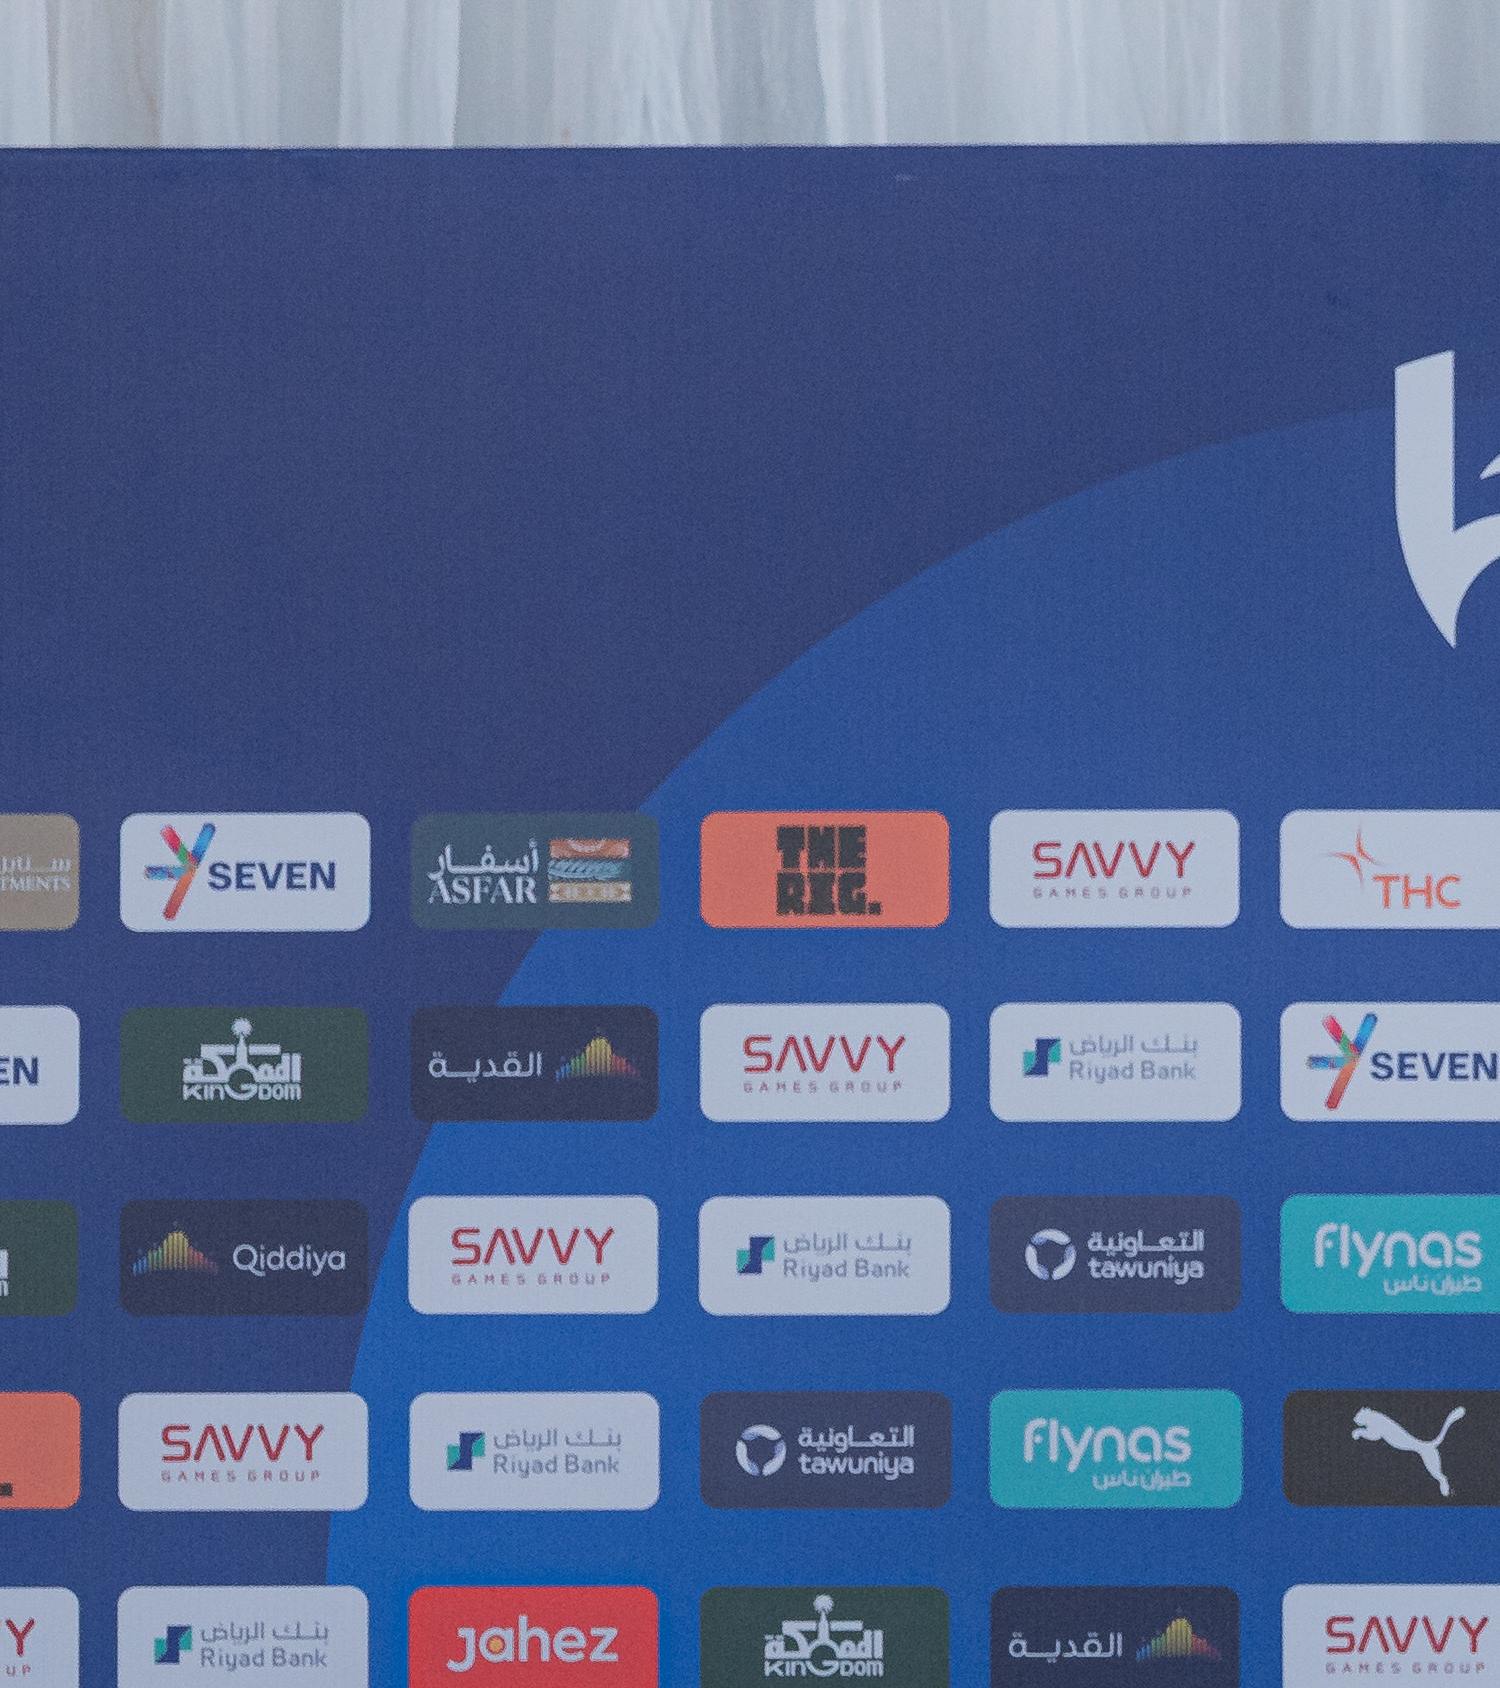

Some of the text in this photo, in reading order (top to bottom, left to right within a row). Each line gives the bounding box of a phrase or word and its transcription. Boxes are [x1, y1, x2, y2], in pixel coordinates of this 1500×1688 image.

[777, 825, 867, 871] THE
[1032, 841, 1195, 880] SAVVY
[209, 861, 336, 892] SEVEN
[428, 877, 537, 904] ASFAR
[1373, 874, 1463, 910] THC
[428, 1052, 542, 1081] القدية
[742, 1035, 906, 1074] SAVVY
[1371, 1051, 1499, 1082] SEVEN
[1069, 1062, 1196, 1085] Riyad Bank
[232, 1242, 346, 1277] Qiddiya
[450, 1227, 614, 1266] SAVVY
[1314, 1222, 1483, 1278] flynas
[783, 1260, 910, 1283] Riyad Bank
[1087, 1257, 1205, 1285] tawuniya
[160, 1424, 324, 1463] SAVVY
[1023, 1417, 1192, 1473] flynas
[493, 1456, 620, 1479] Riyad Bank
[797, 1453, 915, 1481] tawuniya
[1007, 1633, 1123, 1661] القدية
[1325, 1616, 1489, 1655] SAVVY
[201, 1649, 327, 1672] Riyad Bank
